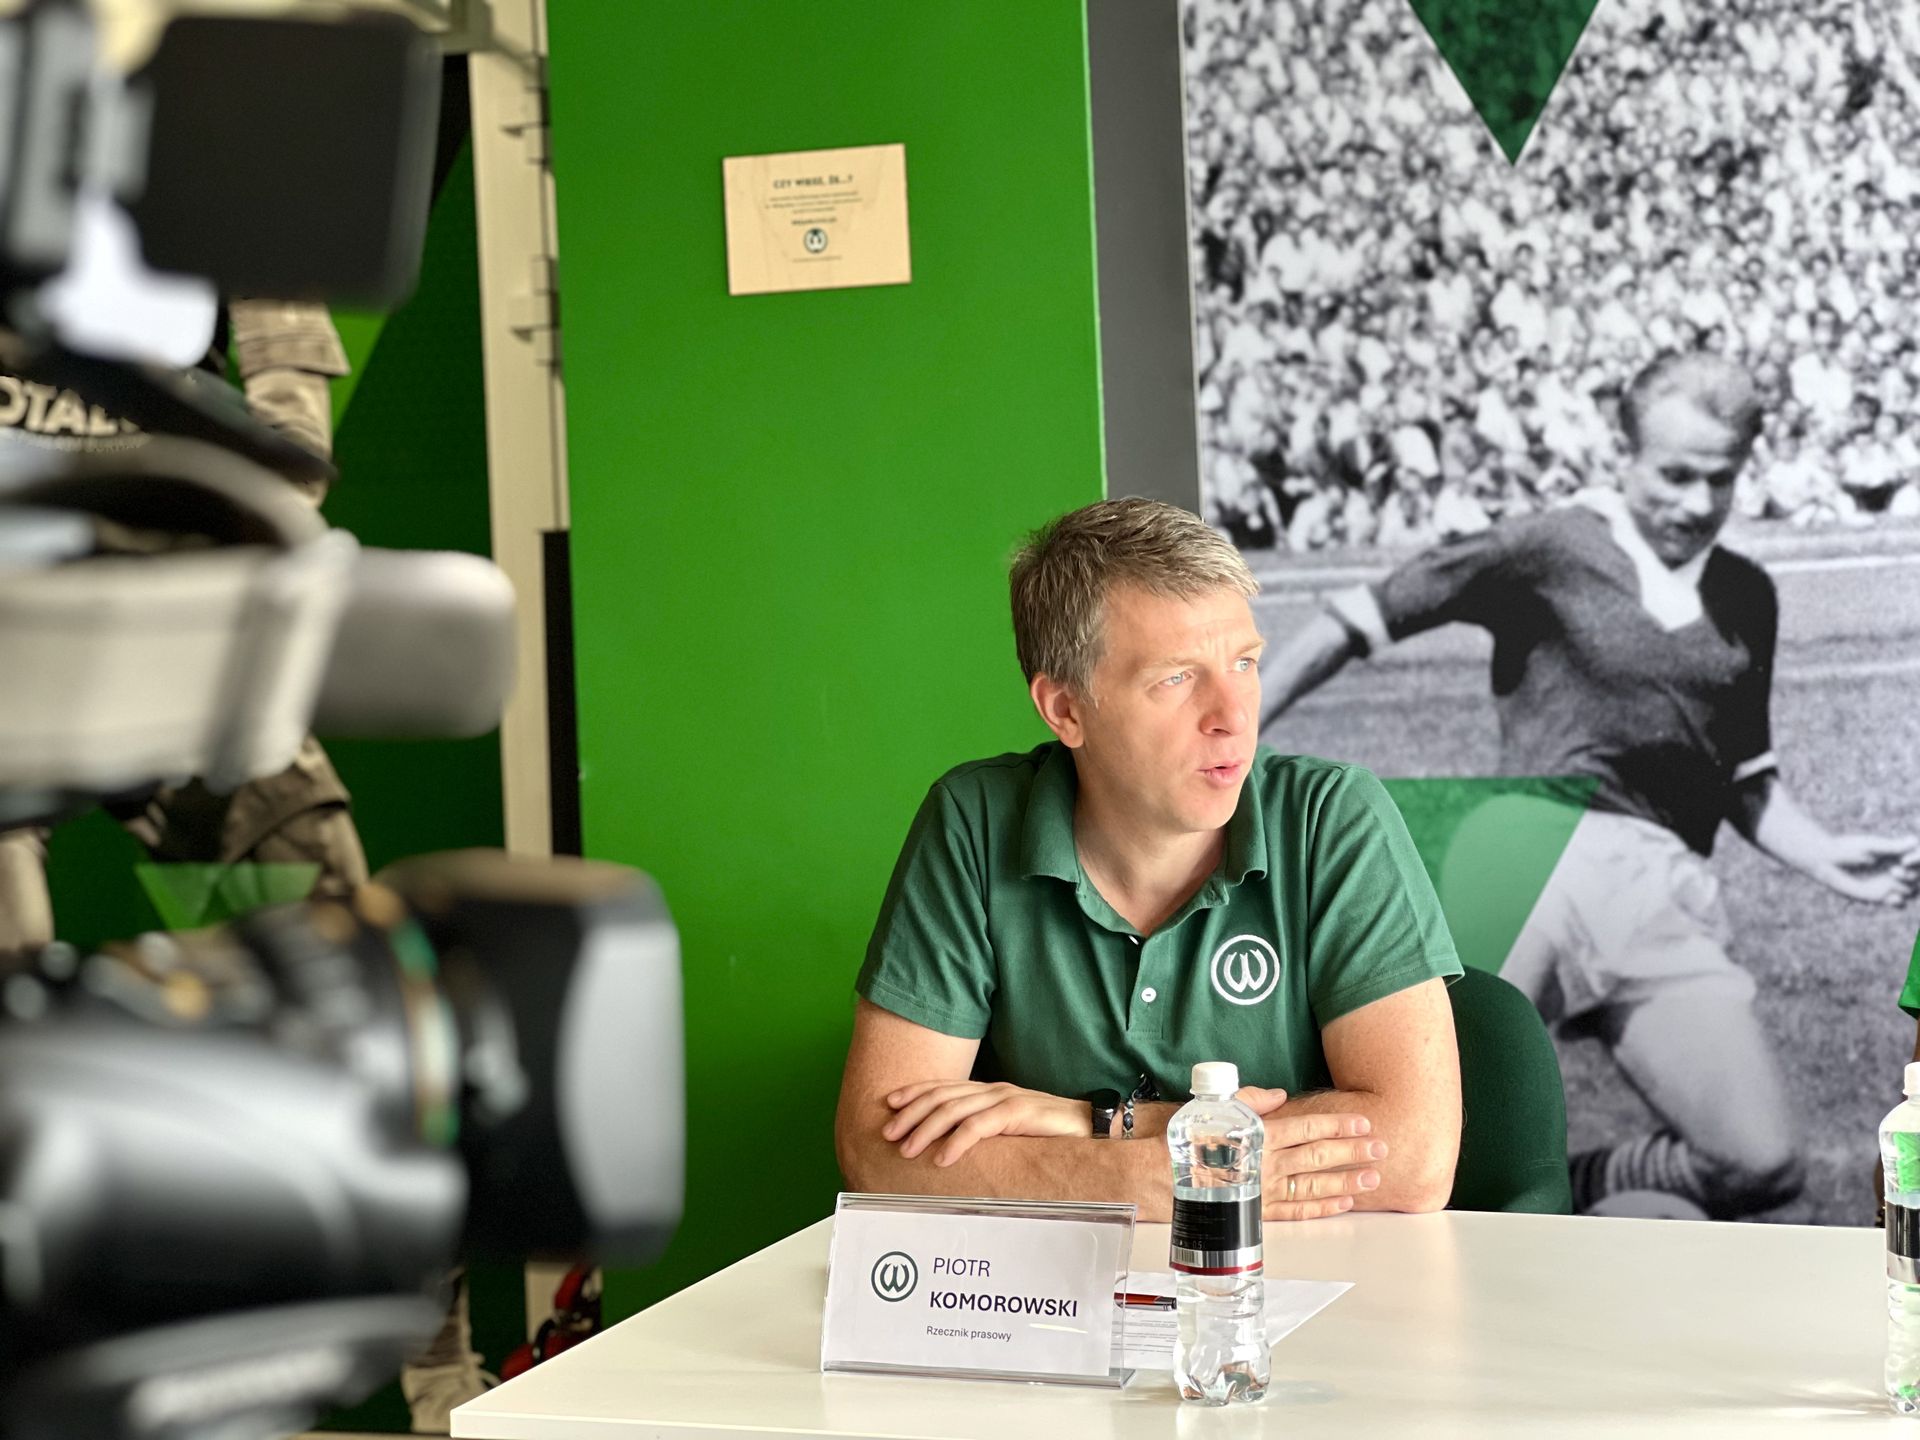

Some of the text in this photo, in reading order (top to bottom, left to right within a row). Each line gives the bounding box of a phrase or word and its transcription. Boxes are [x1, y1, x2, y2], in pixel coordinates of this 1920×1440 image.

[932, 1257, 991, 1278] PIOTR
[929, 1290, 1078, 1318] KOMOROWSKI
[926, 1325, 1012, 1343] Rzecznik prasowy
